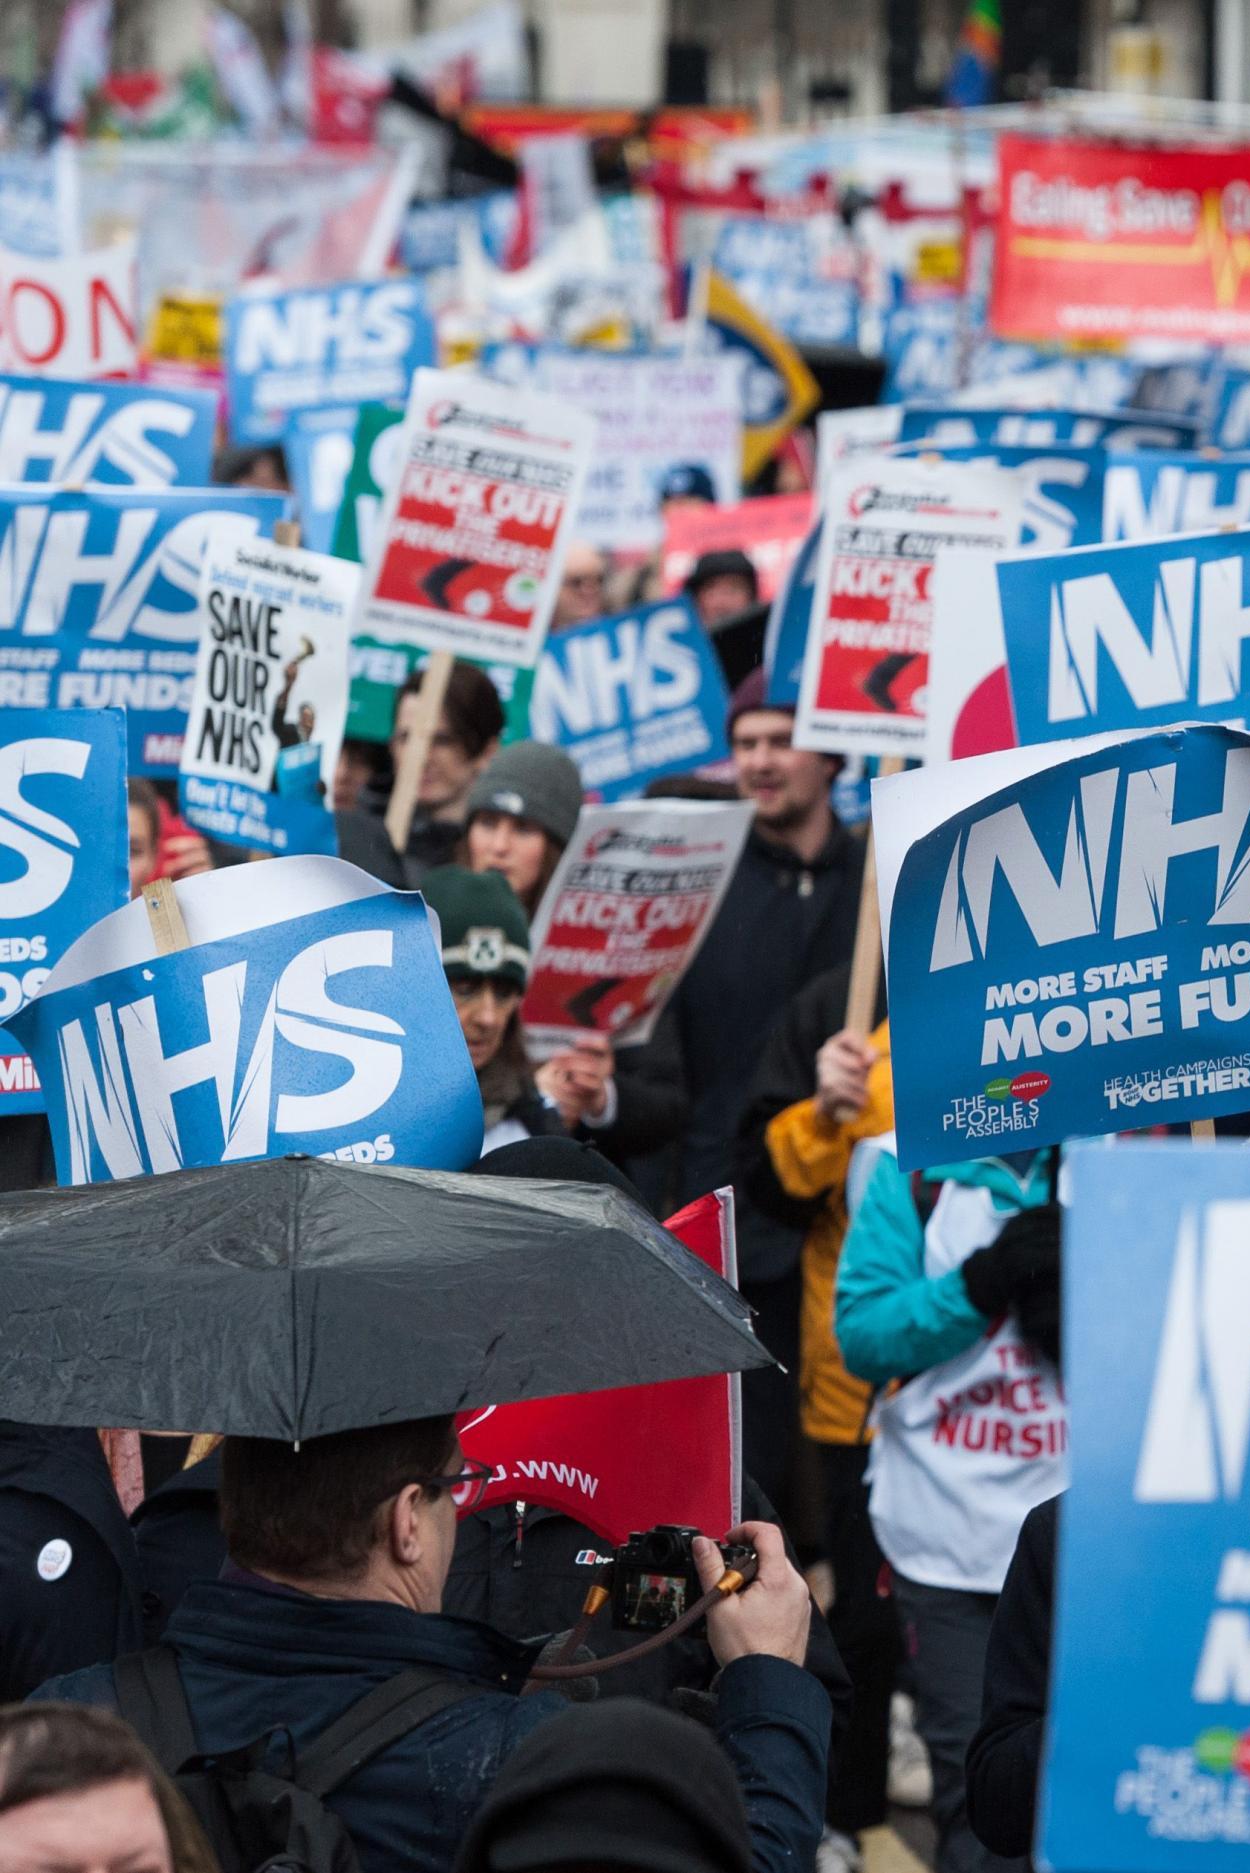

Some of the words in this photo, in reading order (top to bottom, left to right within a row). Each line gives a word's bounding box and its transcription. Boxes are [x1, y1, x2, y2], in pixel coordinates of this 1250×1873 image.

[235, 282, 417, 374] NHS
[0, 380, 194, 490] HS
[832, 555, 918, 603] KICK
[208, 588, 282, 660] SAVE
[0, 671, 49, 709] RE
[207, 647, 270, 717] OUR
[532, 606, 700, 744] NHS
[195, 707, 265, 775] NHS
[554, 892, 650, 931] KICK
[985, 968, 1077, 1012] MORE
[1083, 953, 1169, 991] STAFF
[56, 930, 406, 1184] NHS
[980, 991, 1164, 1067] MORE
[951, 1094, 987, 1112] THE
[1010, 1078, 1049, 1092] AUSTERITY
[1103, 1069, 1162, 1093] HEALTH
[316, 1133, 395, 1165] EDS
[965, 1115, 1040, 1140] ASSEMBLY
